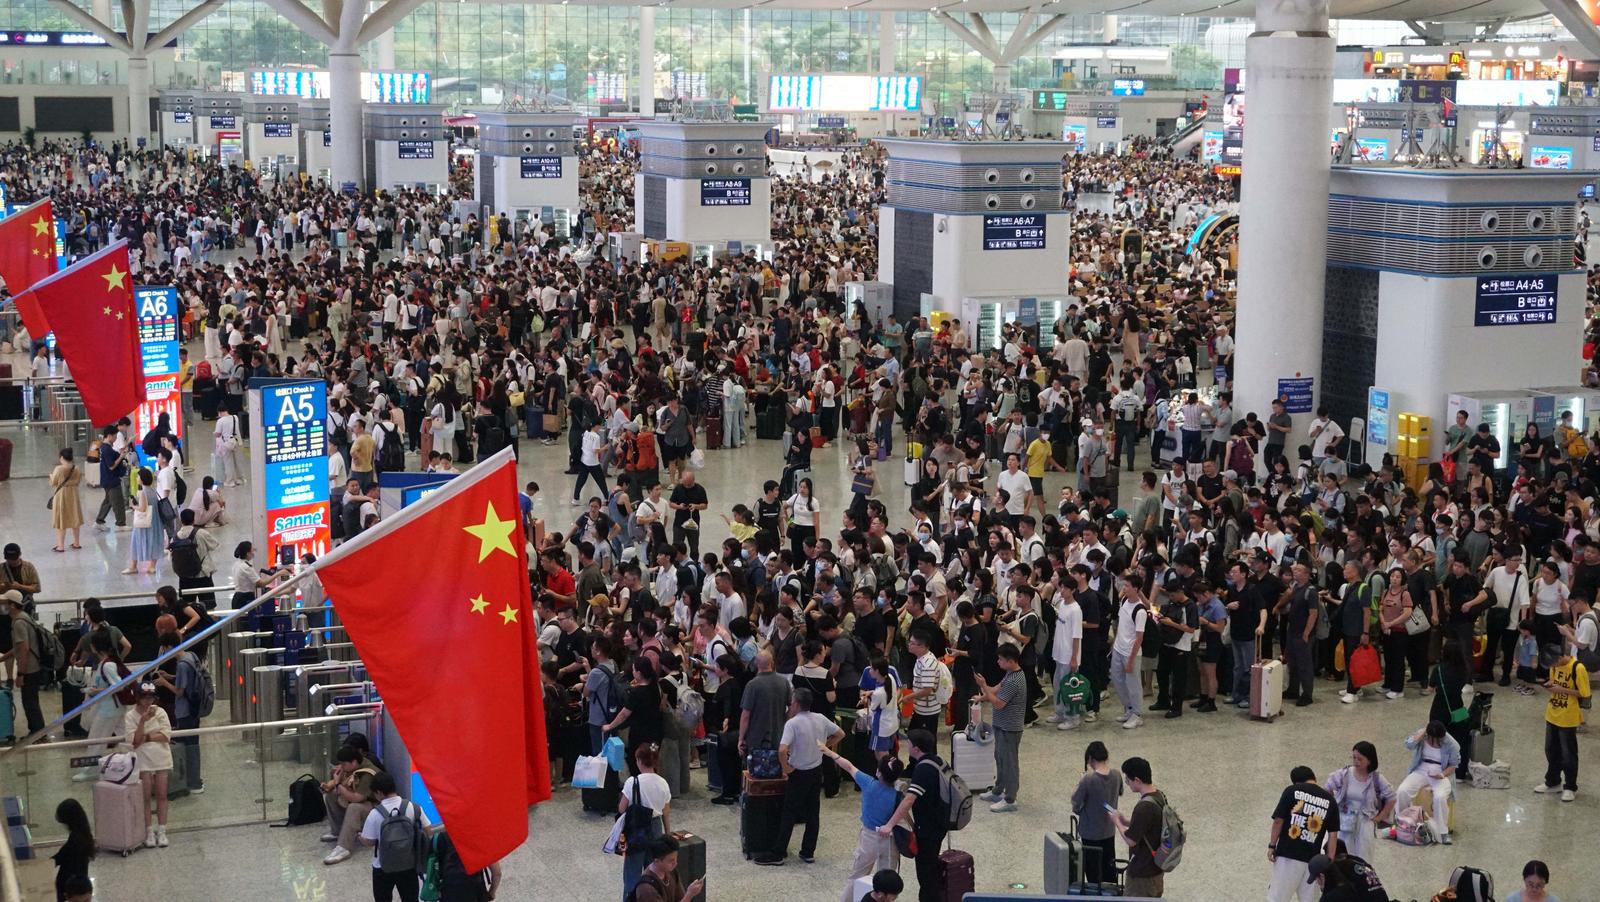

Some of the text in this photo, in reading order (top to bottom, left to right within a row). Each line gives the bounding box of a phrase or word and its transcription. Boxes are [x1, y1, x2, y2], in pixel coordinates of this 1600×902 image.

[1015, 229, 1021, 237] B
[140, 295, 168, 317] A6
[1518, 297, 1525, 307] B
[145, 380, 175, 391] anne
[293, 386, 309, 394] Check
[277, 393, 314, 424] A5
[275, 510, 323, 533] sanne
[1294, 790, 1330, 809] GROWING
[1303, 802, 1328, 820] UPON
[1290, 813, 1307, 828] THE
